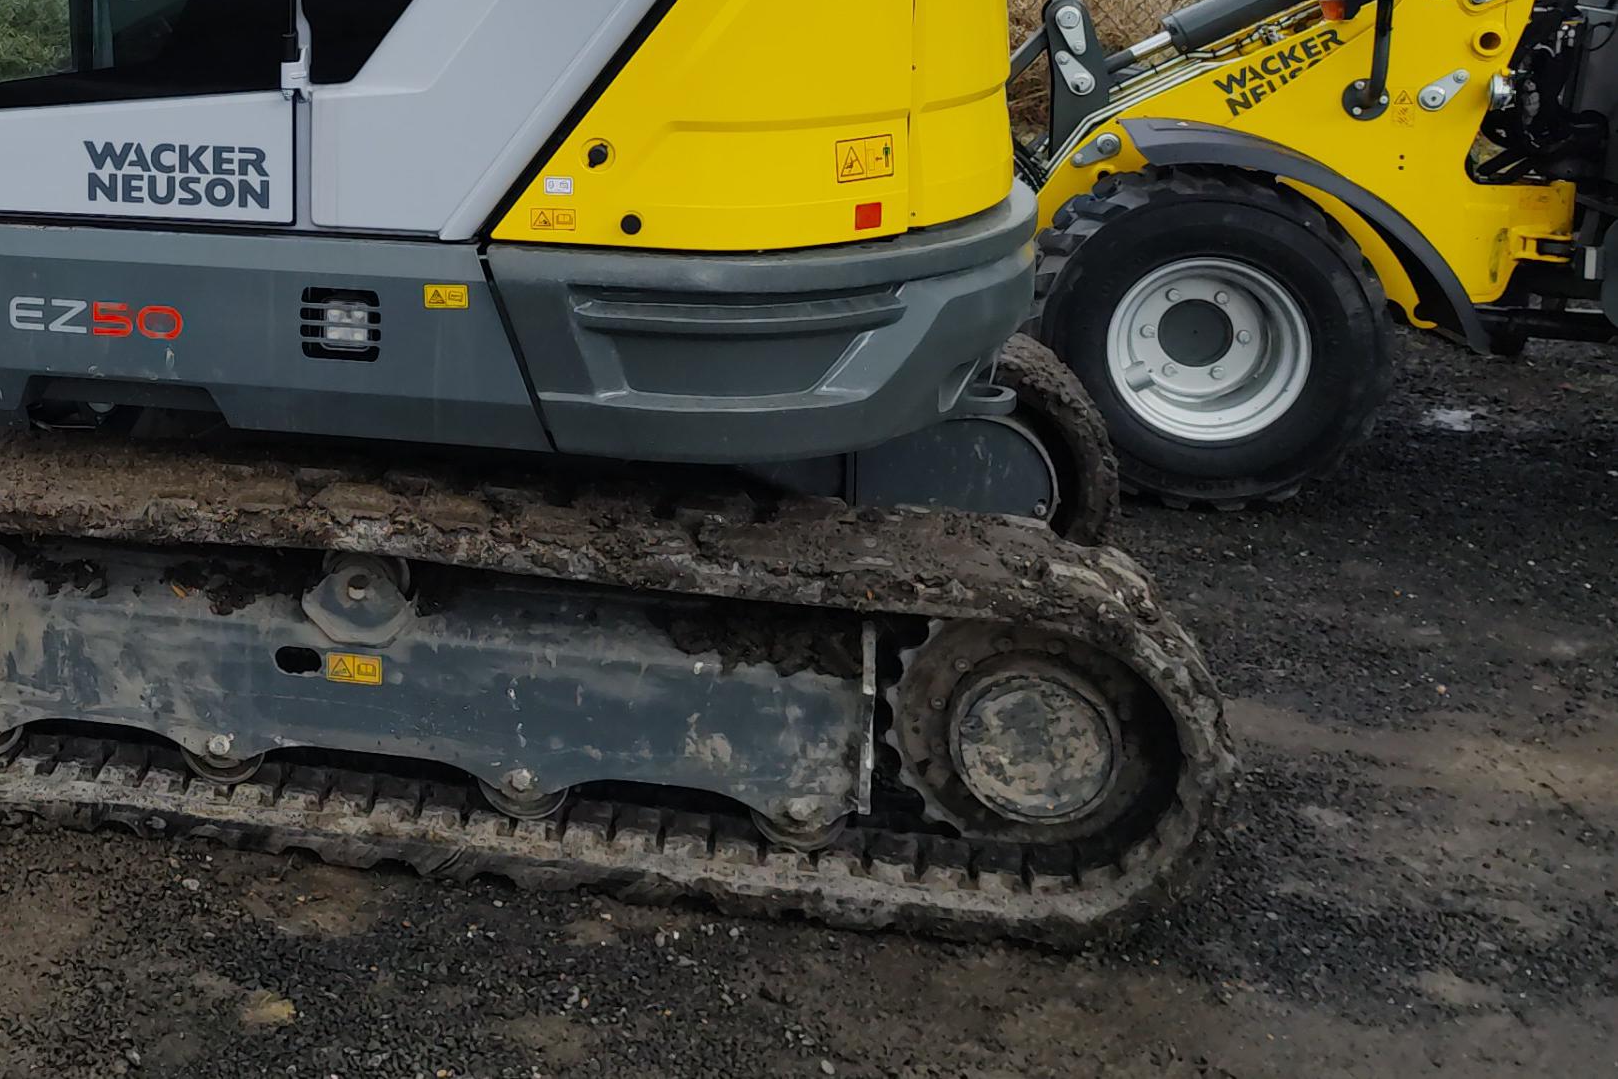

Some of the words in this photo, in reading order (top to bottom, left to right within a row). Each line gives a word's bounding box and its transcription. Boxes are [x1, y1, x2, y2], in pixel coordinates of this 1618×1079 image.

[1213, 29, 1346, 95] WACKER
[83, 140, 270, 177] WACKER
[88, 172, 270, 209] NEUSON
[9, 295, 183, 340] EZ50
